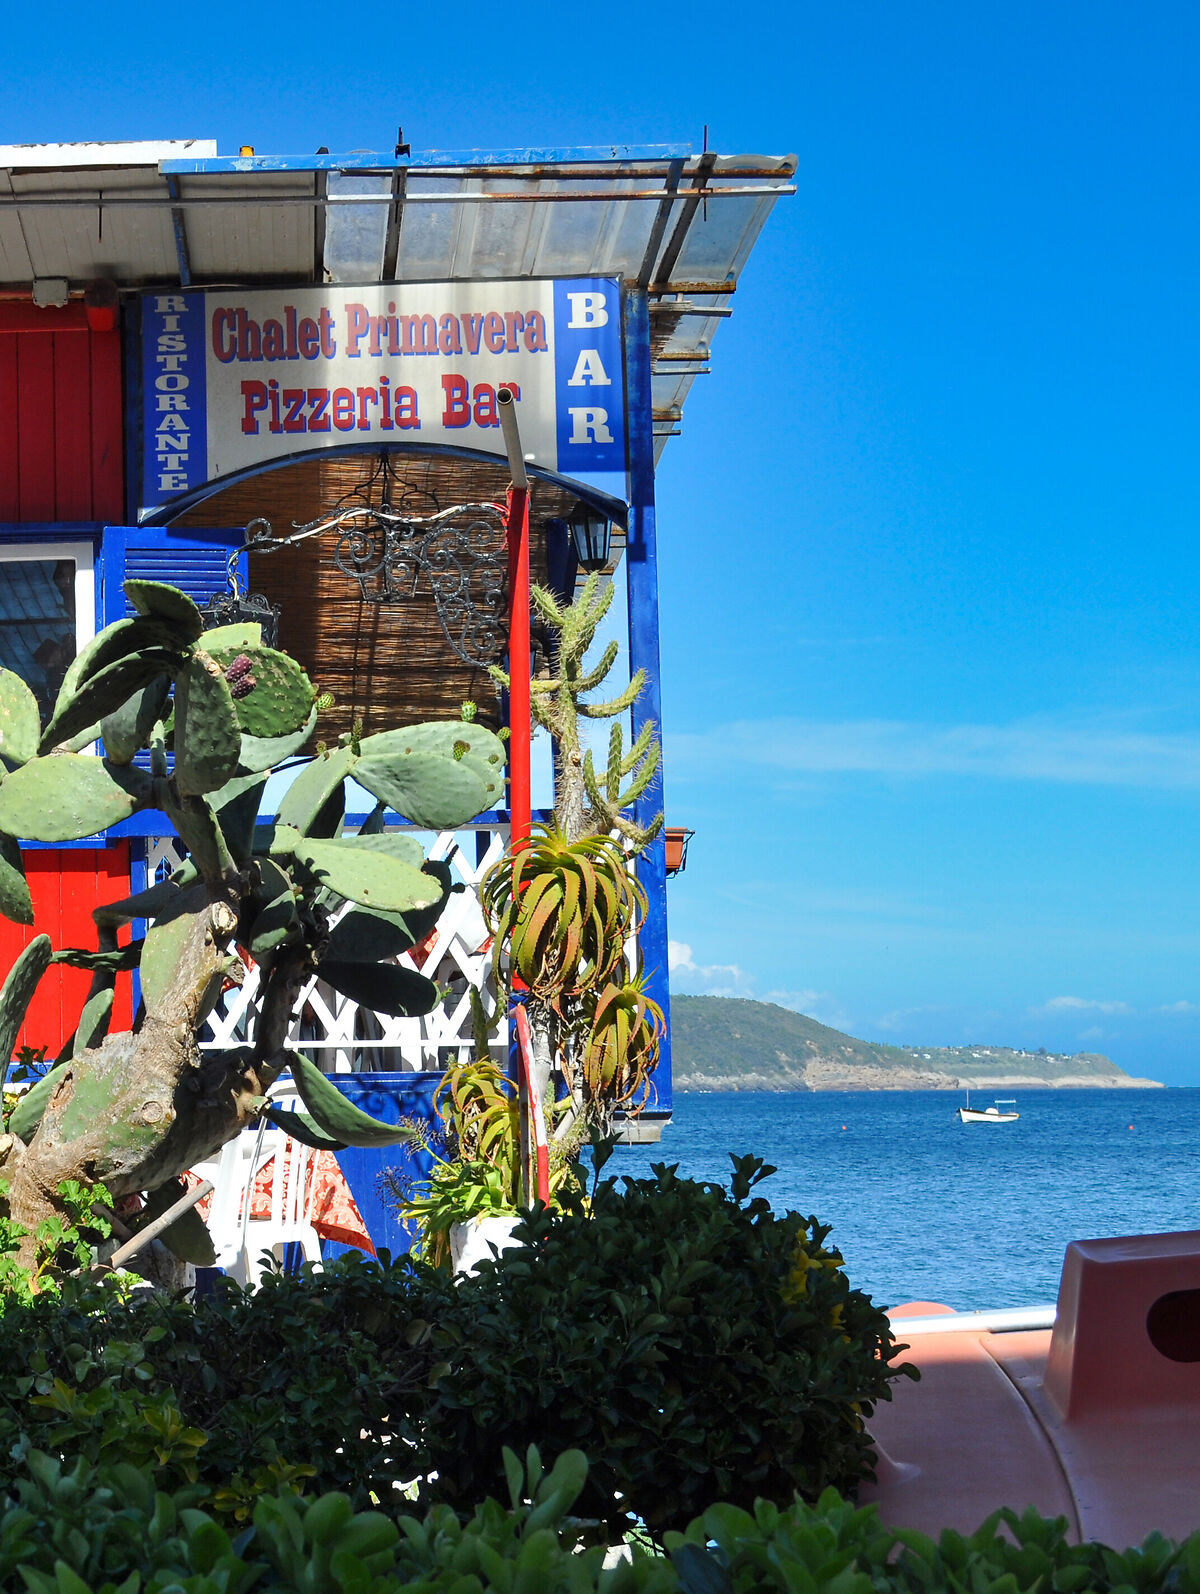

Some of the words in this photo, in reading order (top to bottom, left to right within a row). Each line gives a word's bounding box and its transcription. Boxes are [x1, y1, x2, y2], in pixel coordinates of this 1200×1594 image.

[212, 305, 337, 363] Chalet
[345, 301, 548, 359] Primavera
[567, 292, 614, 445] BAR
[154, 295, 191, 491] RISTORANTE
[240, 375, 421, 434] Pizzeria
